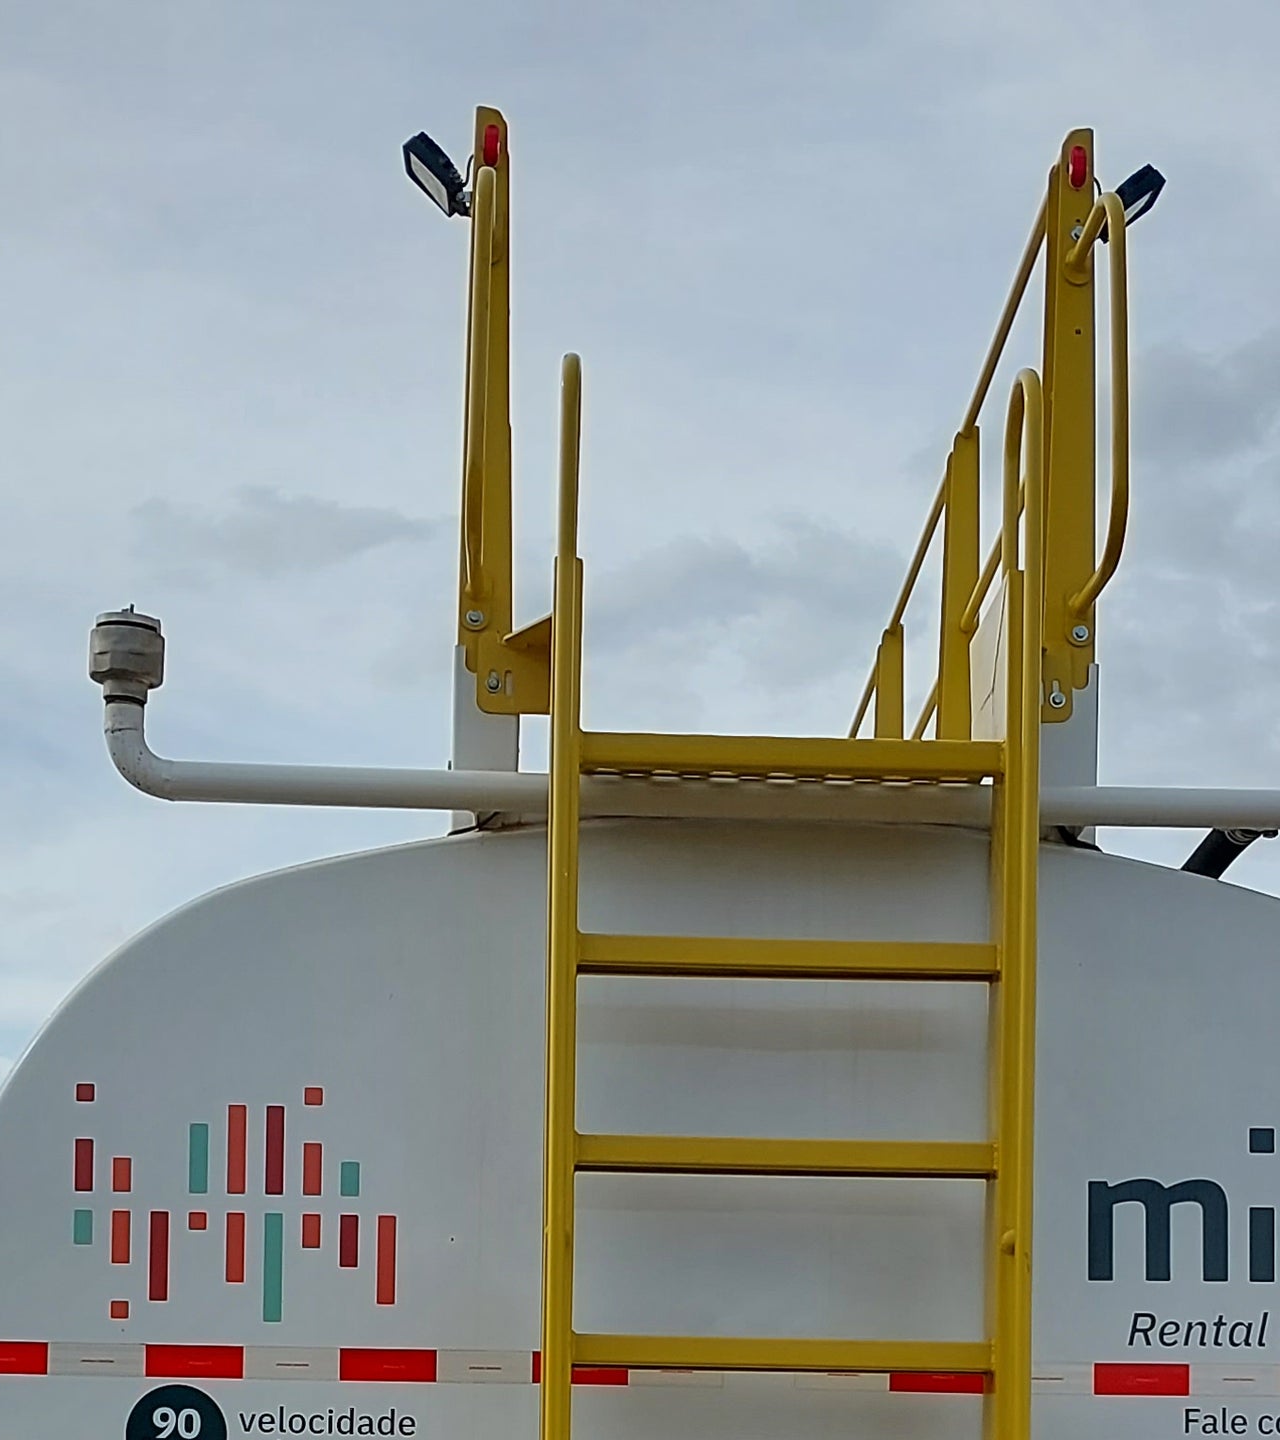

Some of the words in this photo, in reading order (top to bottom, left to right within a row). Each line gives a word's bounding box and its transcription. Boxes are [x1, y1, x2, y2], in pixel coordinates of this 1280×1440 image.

[1128, 1312, 1268, 1347] Rental
[152, 1407, 201, 1440] 90
[239, 1406, 416, 1436] velocidade
[1185, 1408, 1247, 1434] Fale
